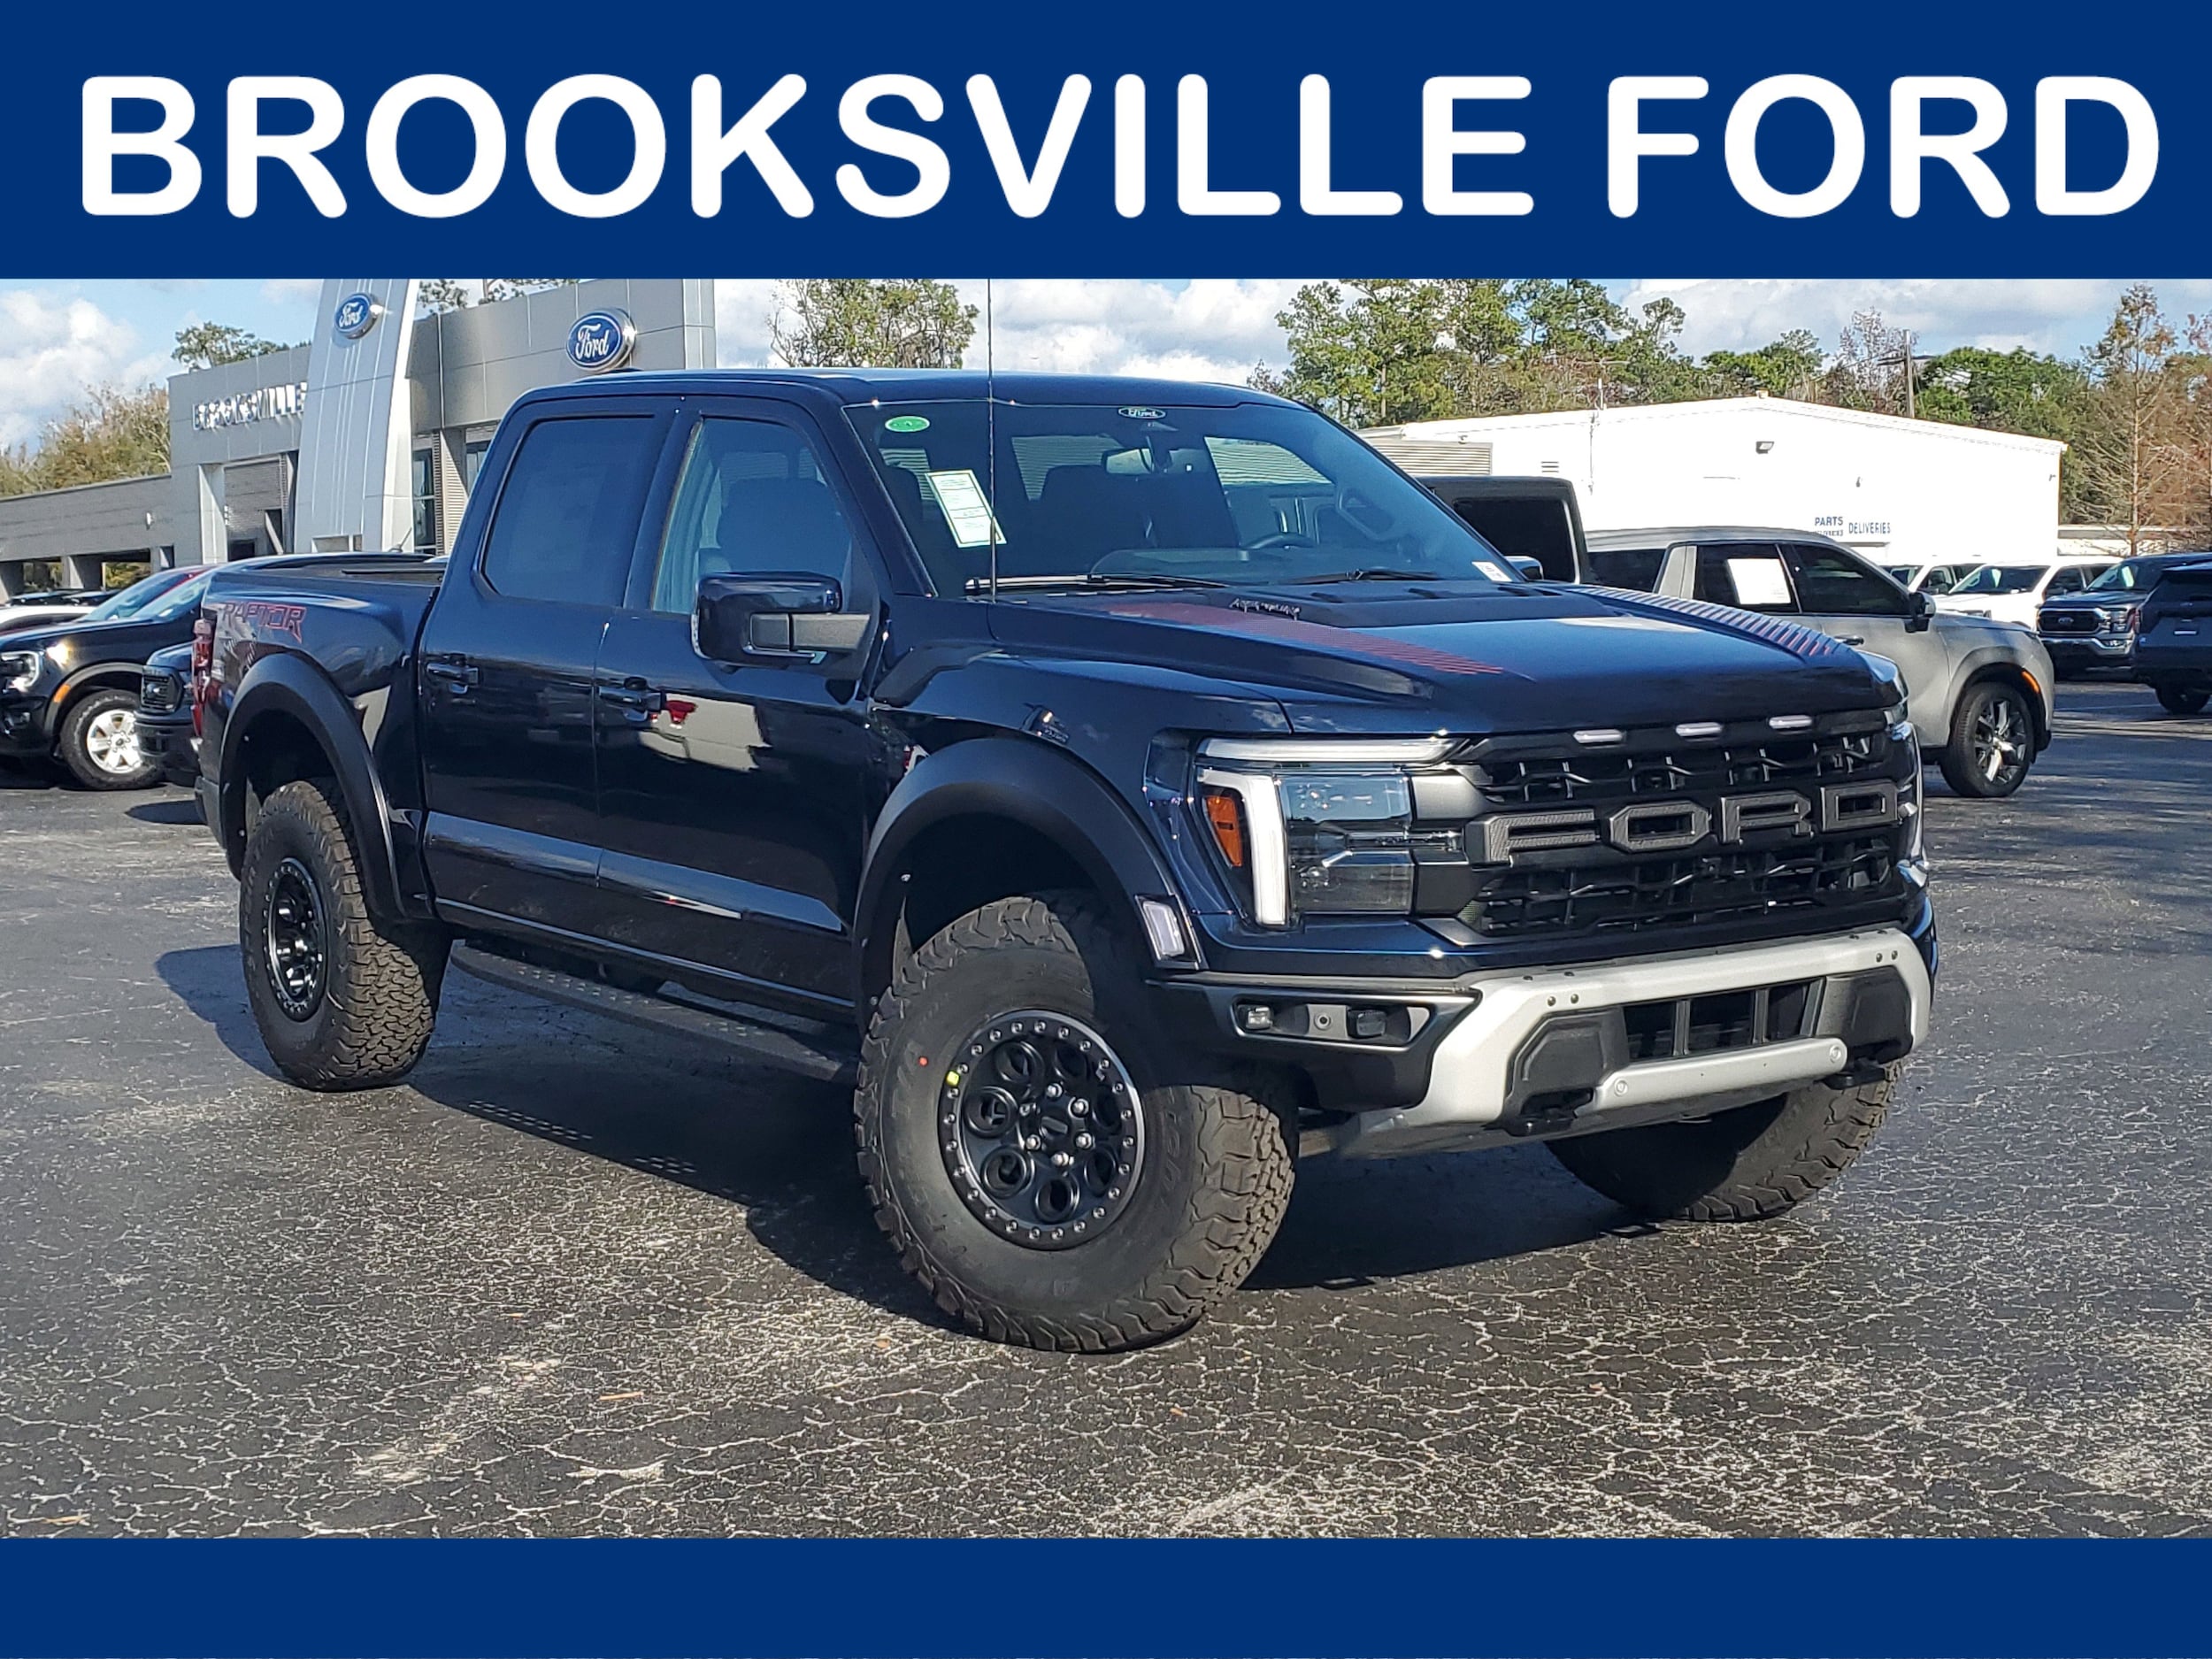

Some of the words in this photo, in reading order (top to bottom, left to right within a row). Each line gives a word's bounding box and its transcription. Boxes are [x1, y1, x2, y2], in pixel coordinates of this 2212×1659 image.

[338, 301, 364, 327] Ford
[575, 323, 610, 360] Ford
[192, 381, 307, 431] BROOKSVILLE
[1815, 516, 1844, 526] PARTS
[1848, 522, 1891, 534] DELIVERIES
[1466, 780, 1901, 866] FORD
